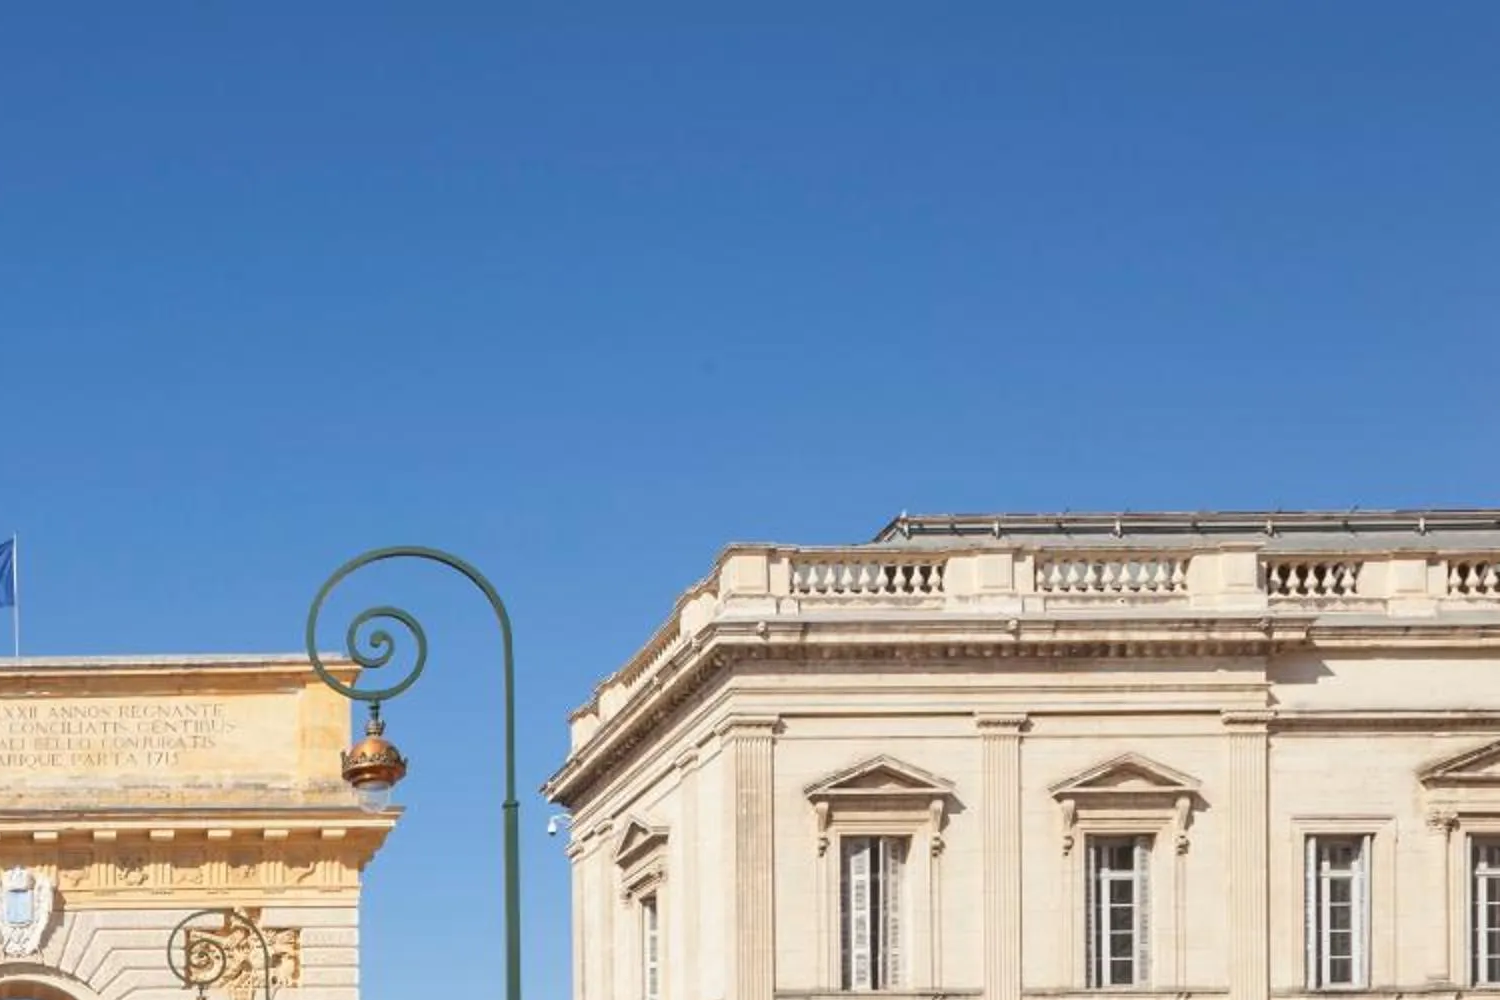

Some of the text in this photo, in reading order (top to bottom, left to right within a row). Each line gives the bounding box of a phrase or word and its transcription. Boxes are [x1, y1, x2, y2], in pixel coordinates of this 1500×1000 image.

[49, 705, 112, 719] ANNOS
[118, 703, 223, 718] REGNANTE
[8, 721, 130, 735] CONCILIATIS
[137, 719, 236, 734] GENTIBUS
[70, 752, 139, 767] PARTA
